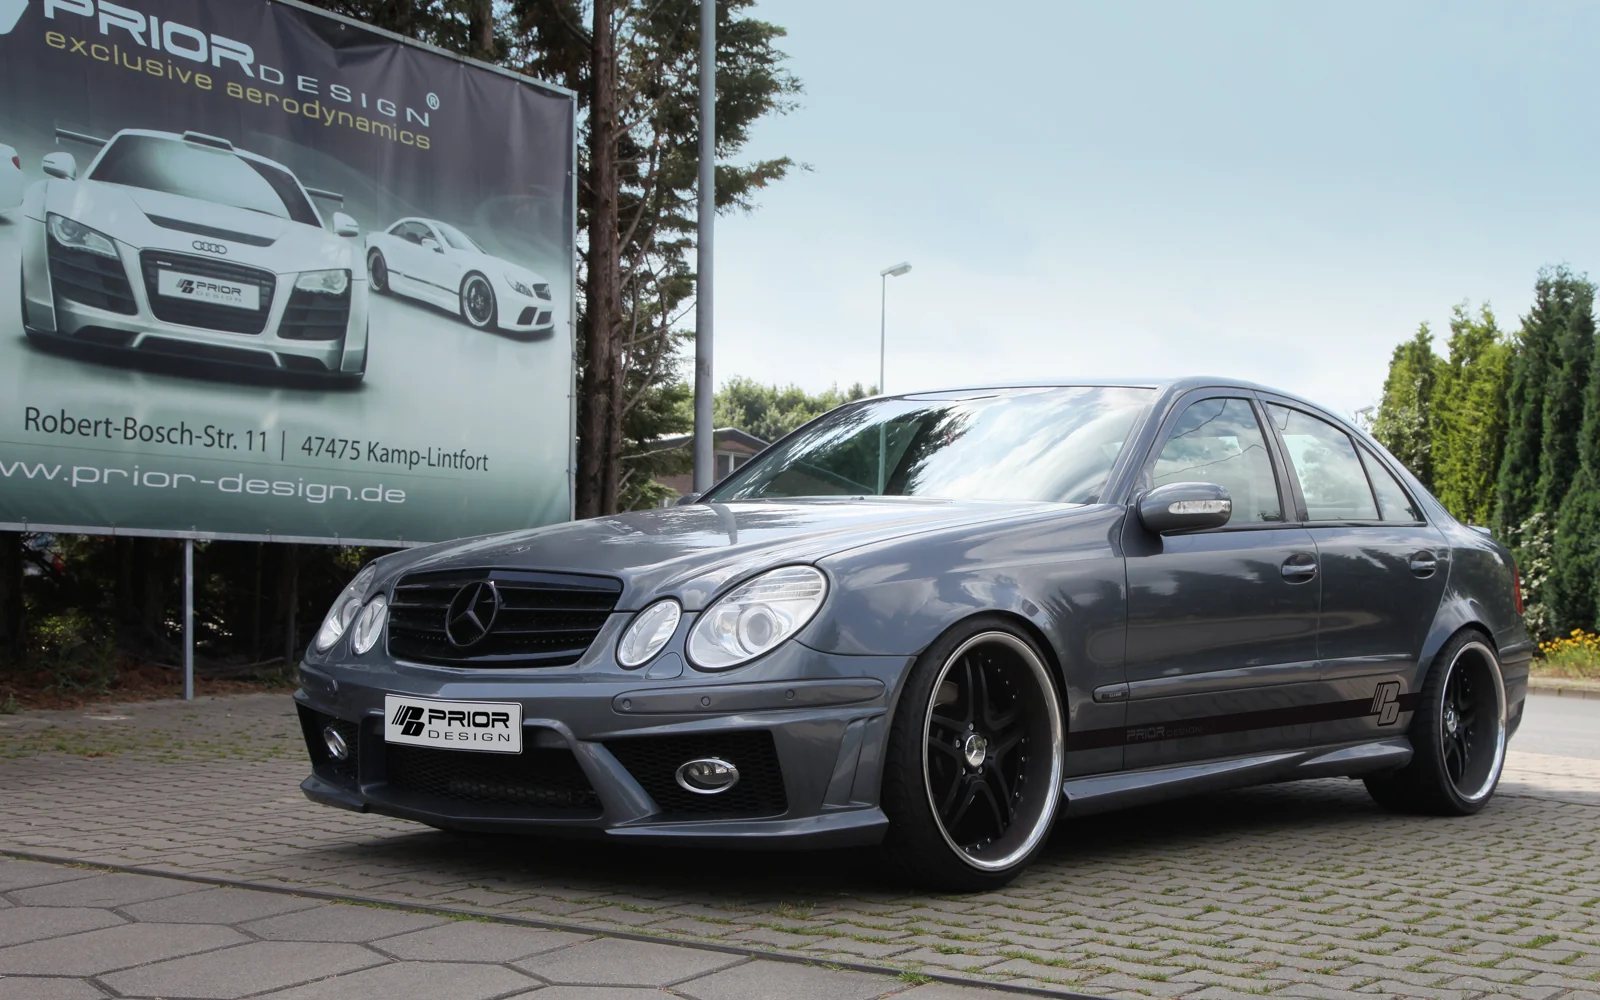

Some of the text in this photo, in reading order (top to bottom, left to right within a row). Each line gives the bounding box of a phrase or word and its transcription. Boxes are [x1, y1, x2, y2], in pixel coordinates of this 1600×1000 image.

[44, 0, 255, 78] PRIOR
[45, 30, 431, 150] exclusive aerodynamics
[196, 281, 241, 296] PRIOR
[24, 406, 238, 451] Robert-Bosch-Str.
[246, 430, 267, 453] 11
[301, 435, 361, 460] 47475
[367, 441, 489, 472] Kamp-Lintfort
[428, 708, 510, 729] PRIOR
[428, 730, 511, 742] DESIGN
[1126, 726, 1203, 742] PRIOR DESIGN
